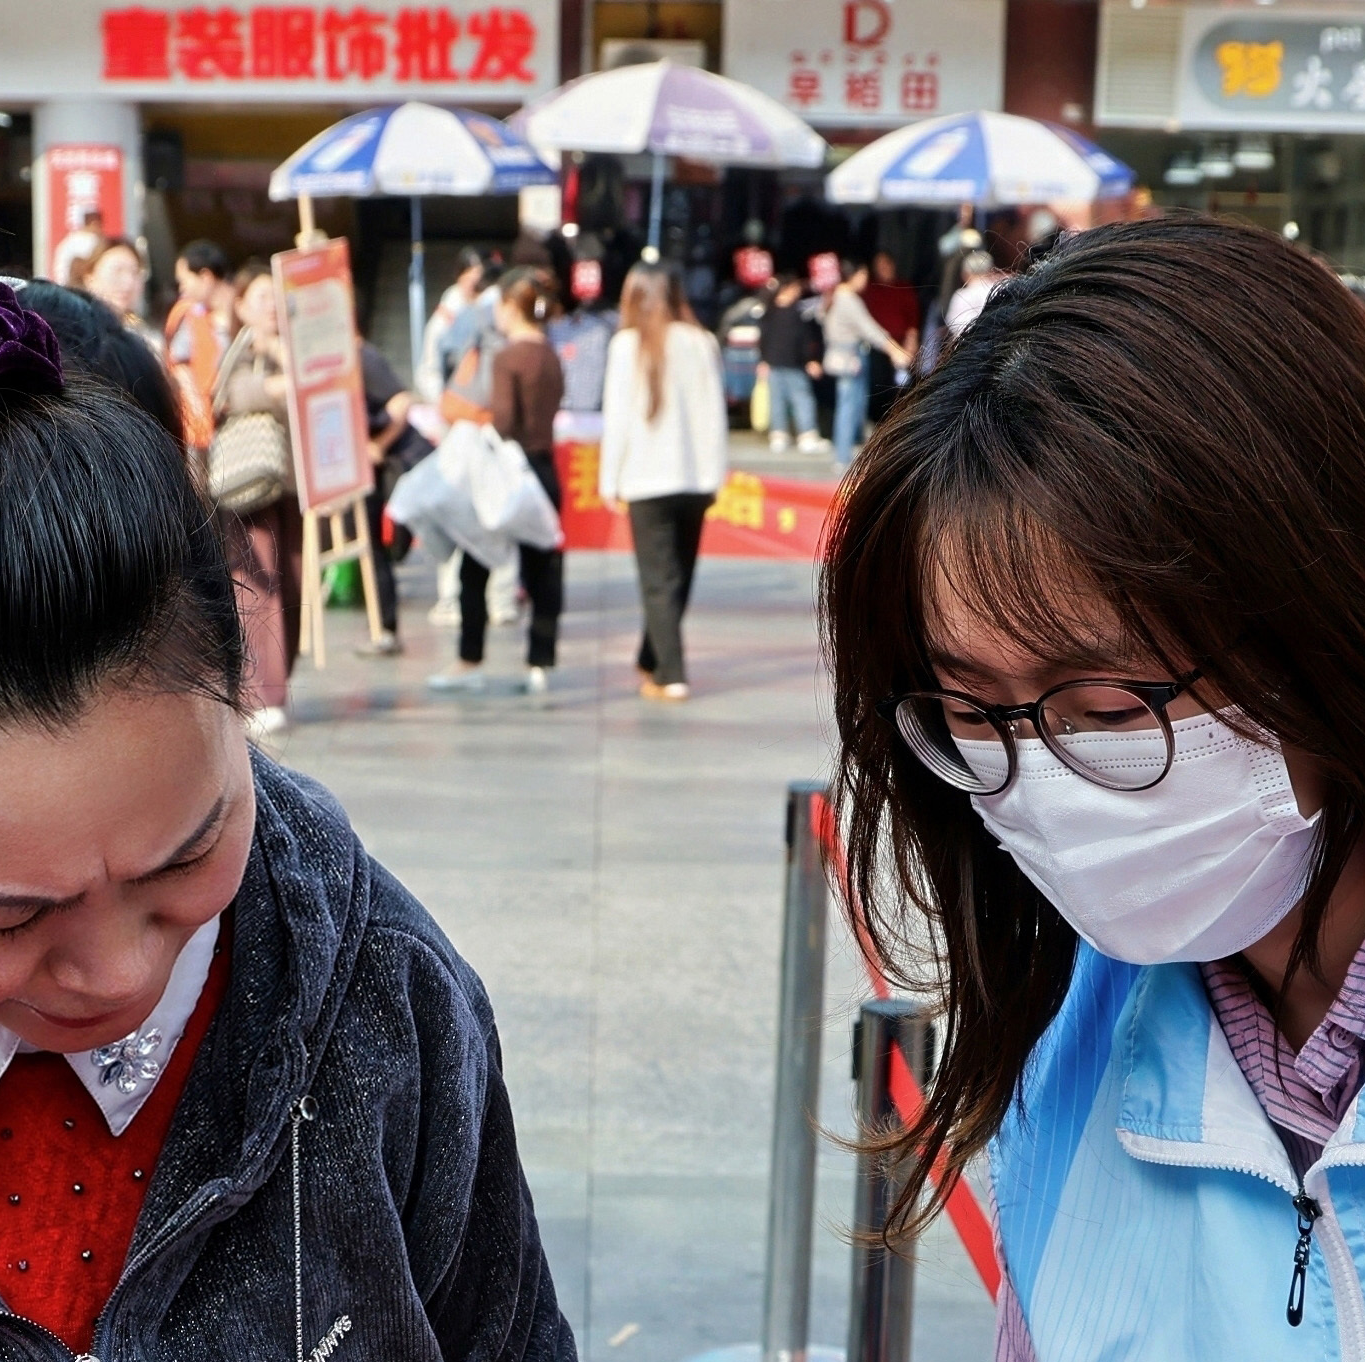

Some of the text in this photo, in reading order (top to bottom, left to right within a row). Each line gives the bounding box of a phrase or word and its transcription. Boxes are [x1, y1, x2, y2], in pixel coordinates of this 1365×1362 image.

[101, 9, 535, 84] 童装服饰批发
[843, 0, 892, 48] D
[789, 70, 939, 111] 早稻田
